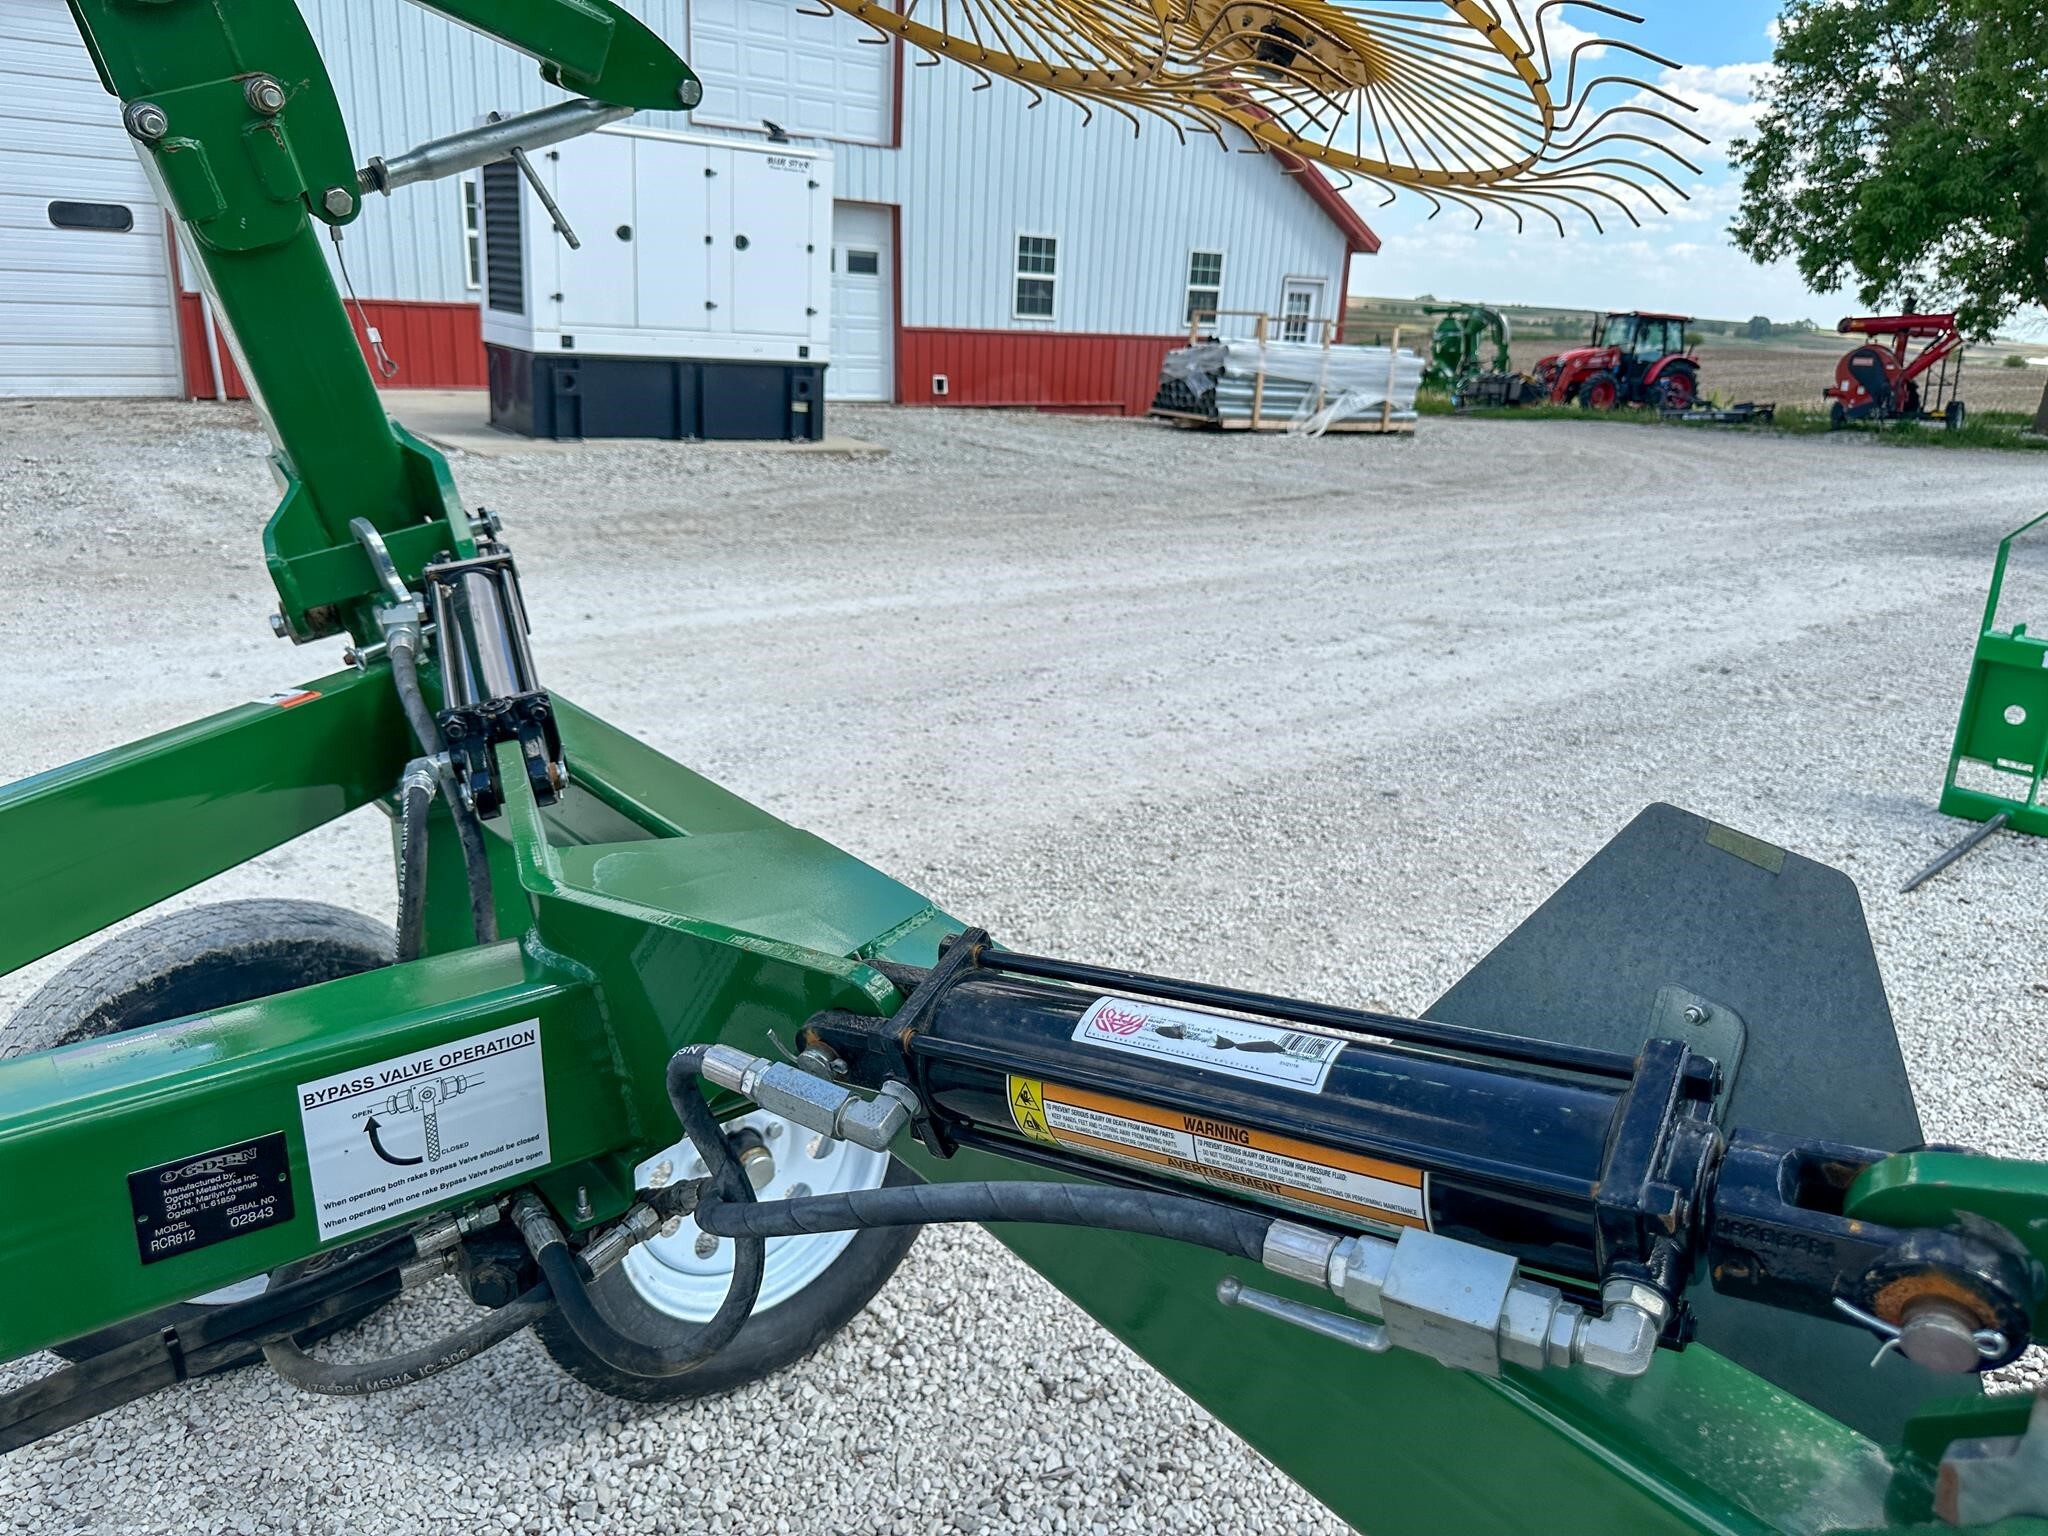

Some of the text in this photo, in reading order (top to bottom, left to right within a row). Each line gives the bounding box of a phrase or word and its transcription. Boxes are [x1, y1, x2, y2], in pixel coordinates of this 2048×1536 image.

[303, 1030, 535, 1106] BYPASS VALVE OPERATION
[350, 1107, 375, 1119] OPEN
[1052, 1105, 1070, 1115] PREVENT
[1071, 1108, 1089, 1118] SERIOUS
[1090, 1113, 1105, 1122] INJURY
[1113, 1118, 1126, 1127] DEATH
[1128, 1122, 1140, 1130] FROM
[1141, 1125, 1158, 1135] MOVING
[1132, 1132, 1144, 1140] FROM
[1145, 1135, 1162, 1144] MOVING
[1183, 1116, 1250, 1144] WARNING
[441, 1141, 470, 1155] CLOSED
[1204, 1140, 1222, 1151] PREVENT
[1223, 1144, 1241, 1155] SERIOUS
[1242, 1149, 1258, 1159] INJURY
[1266, 1155, 1281, 1165] DEATH
[1281, 1159, 1295, 1167] FROM
[1295, 1162, 1306, 1170] HIGH
[1307, 1166, 1331, 1178] PRESSURE
[160, 1147, 257, 1183] OGDEN
[324, 1134, 540, 1210] When operating both rakes Bypass Valve should be closed
[1167, 1157, 1281, 1193] AVERTISSEMENT
[1294, 1171, 1305, 1179] WITH
[163, 1172, 236, 1196] Manufactured by:
[165, 1174, 259, 1205] Ogden Metalworks Inc.
[166, 1181, 258, 1212] 301 N. Marilyn Avenue
[324, 1217, 347, 1228] When
[349, 1205, 386, 1220] operating
[388, 1198, 404, 1207] with
[406, 1193, 420, 1201] one
[422, 1186, 438, 1196] rake
[440, 1177, 467, 1190] Bypass
[469, 1170, 487, 1180] Valve
[489, 1160, 513, 1172] should
[526, 1151, 543, 1161] open
[1312, 1182, 1344, 1197] CONNECTIONS
[167, 1194, 236, 1220] Ogden, IL 61859
[226, 1195, 278, 1216] SERIAL NO.
[230, 1206, 274, 1228] 02843
[151, 1230, 196, 1252] RCR812
[155, 1221, 191, 1237] MODEL
[366, 1373, 415, 1392] MSHA
[418, 1348, 470, 1377] IC-306
